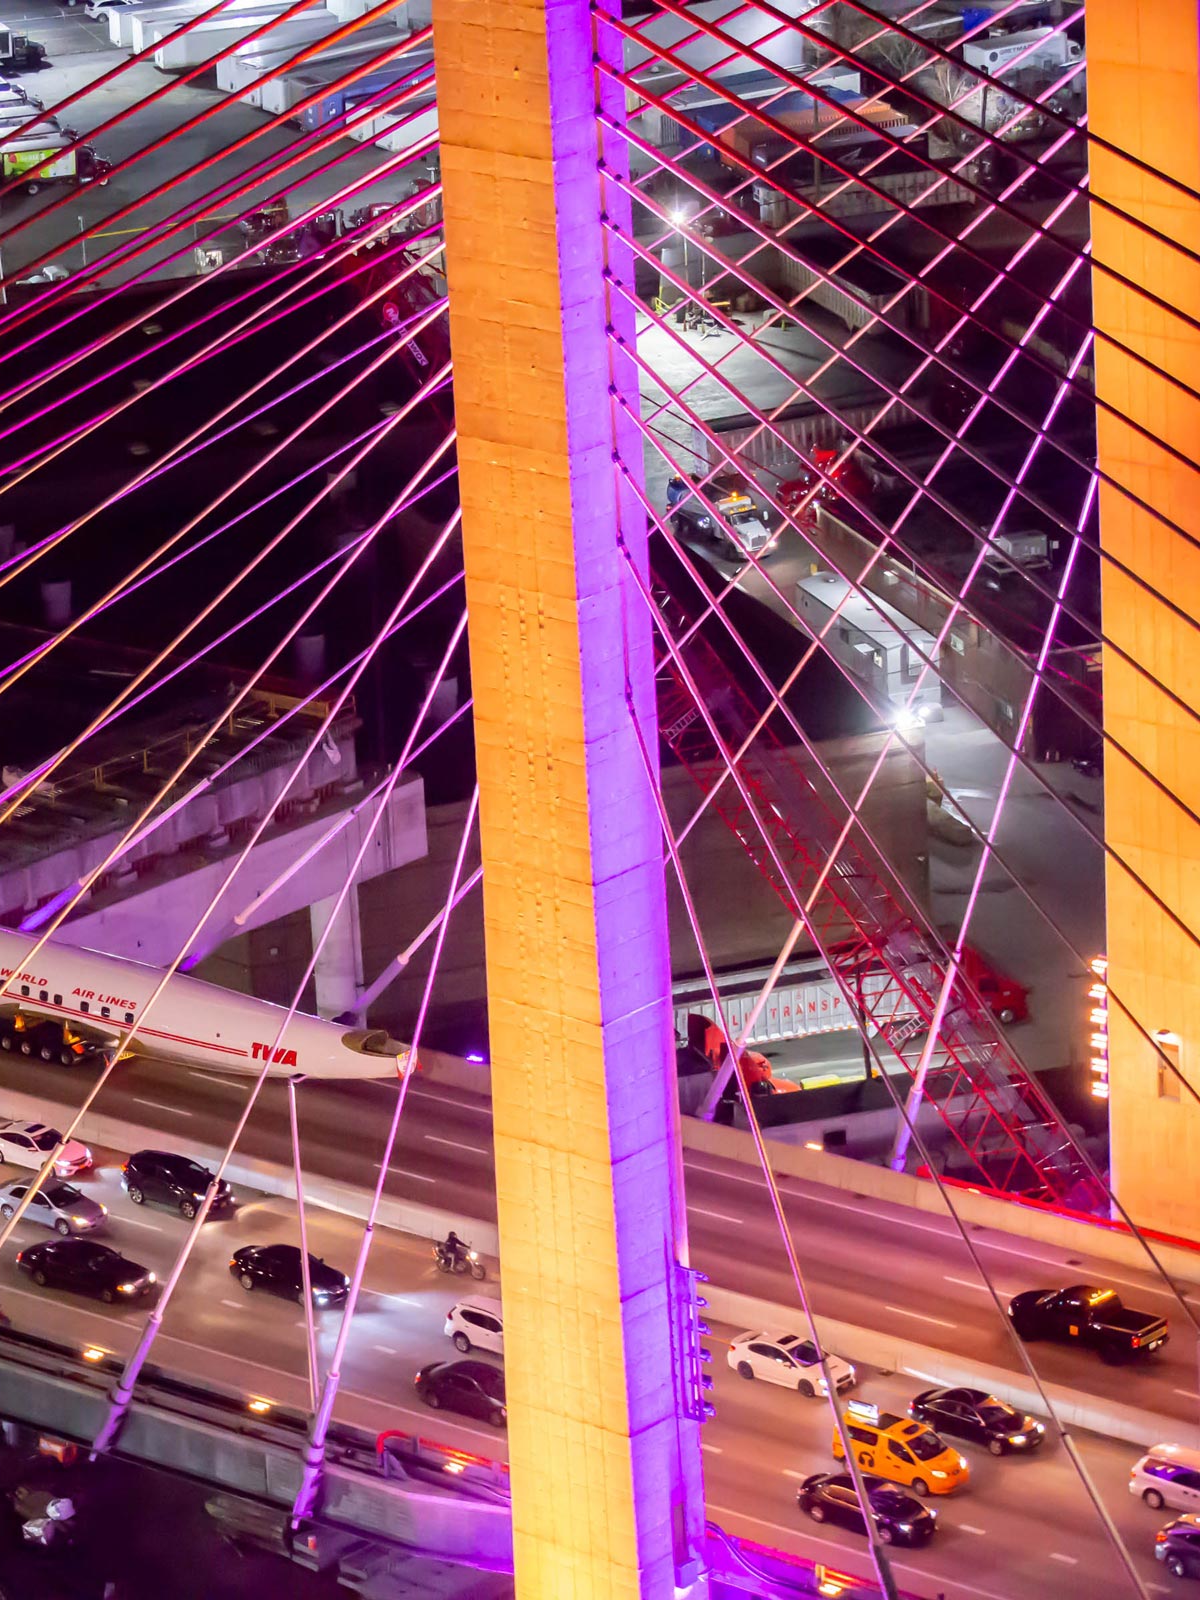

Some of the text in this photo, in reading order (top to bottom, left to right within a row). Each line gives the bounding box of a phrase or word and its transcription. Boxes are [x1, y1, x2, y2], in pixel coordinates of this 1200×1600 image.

[72, 987, 96, 1000] AIR
[97, 994, 137, 1010] LINES
[251, 1042, 298, 1067] TWA
